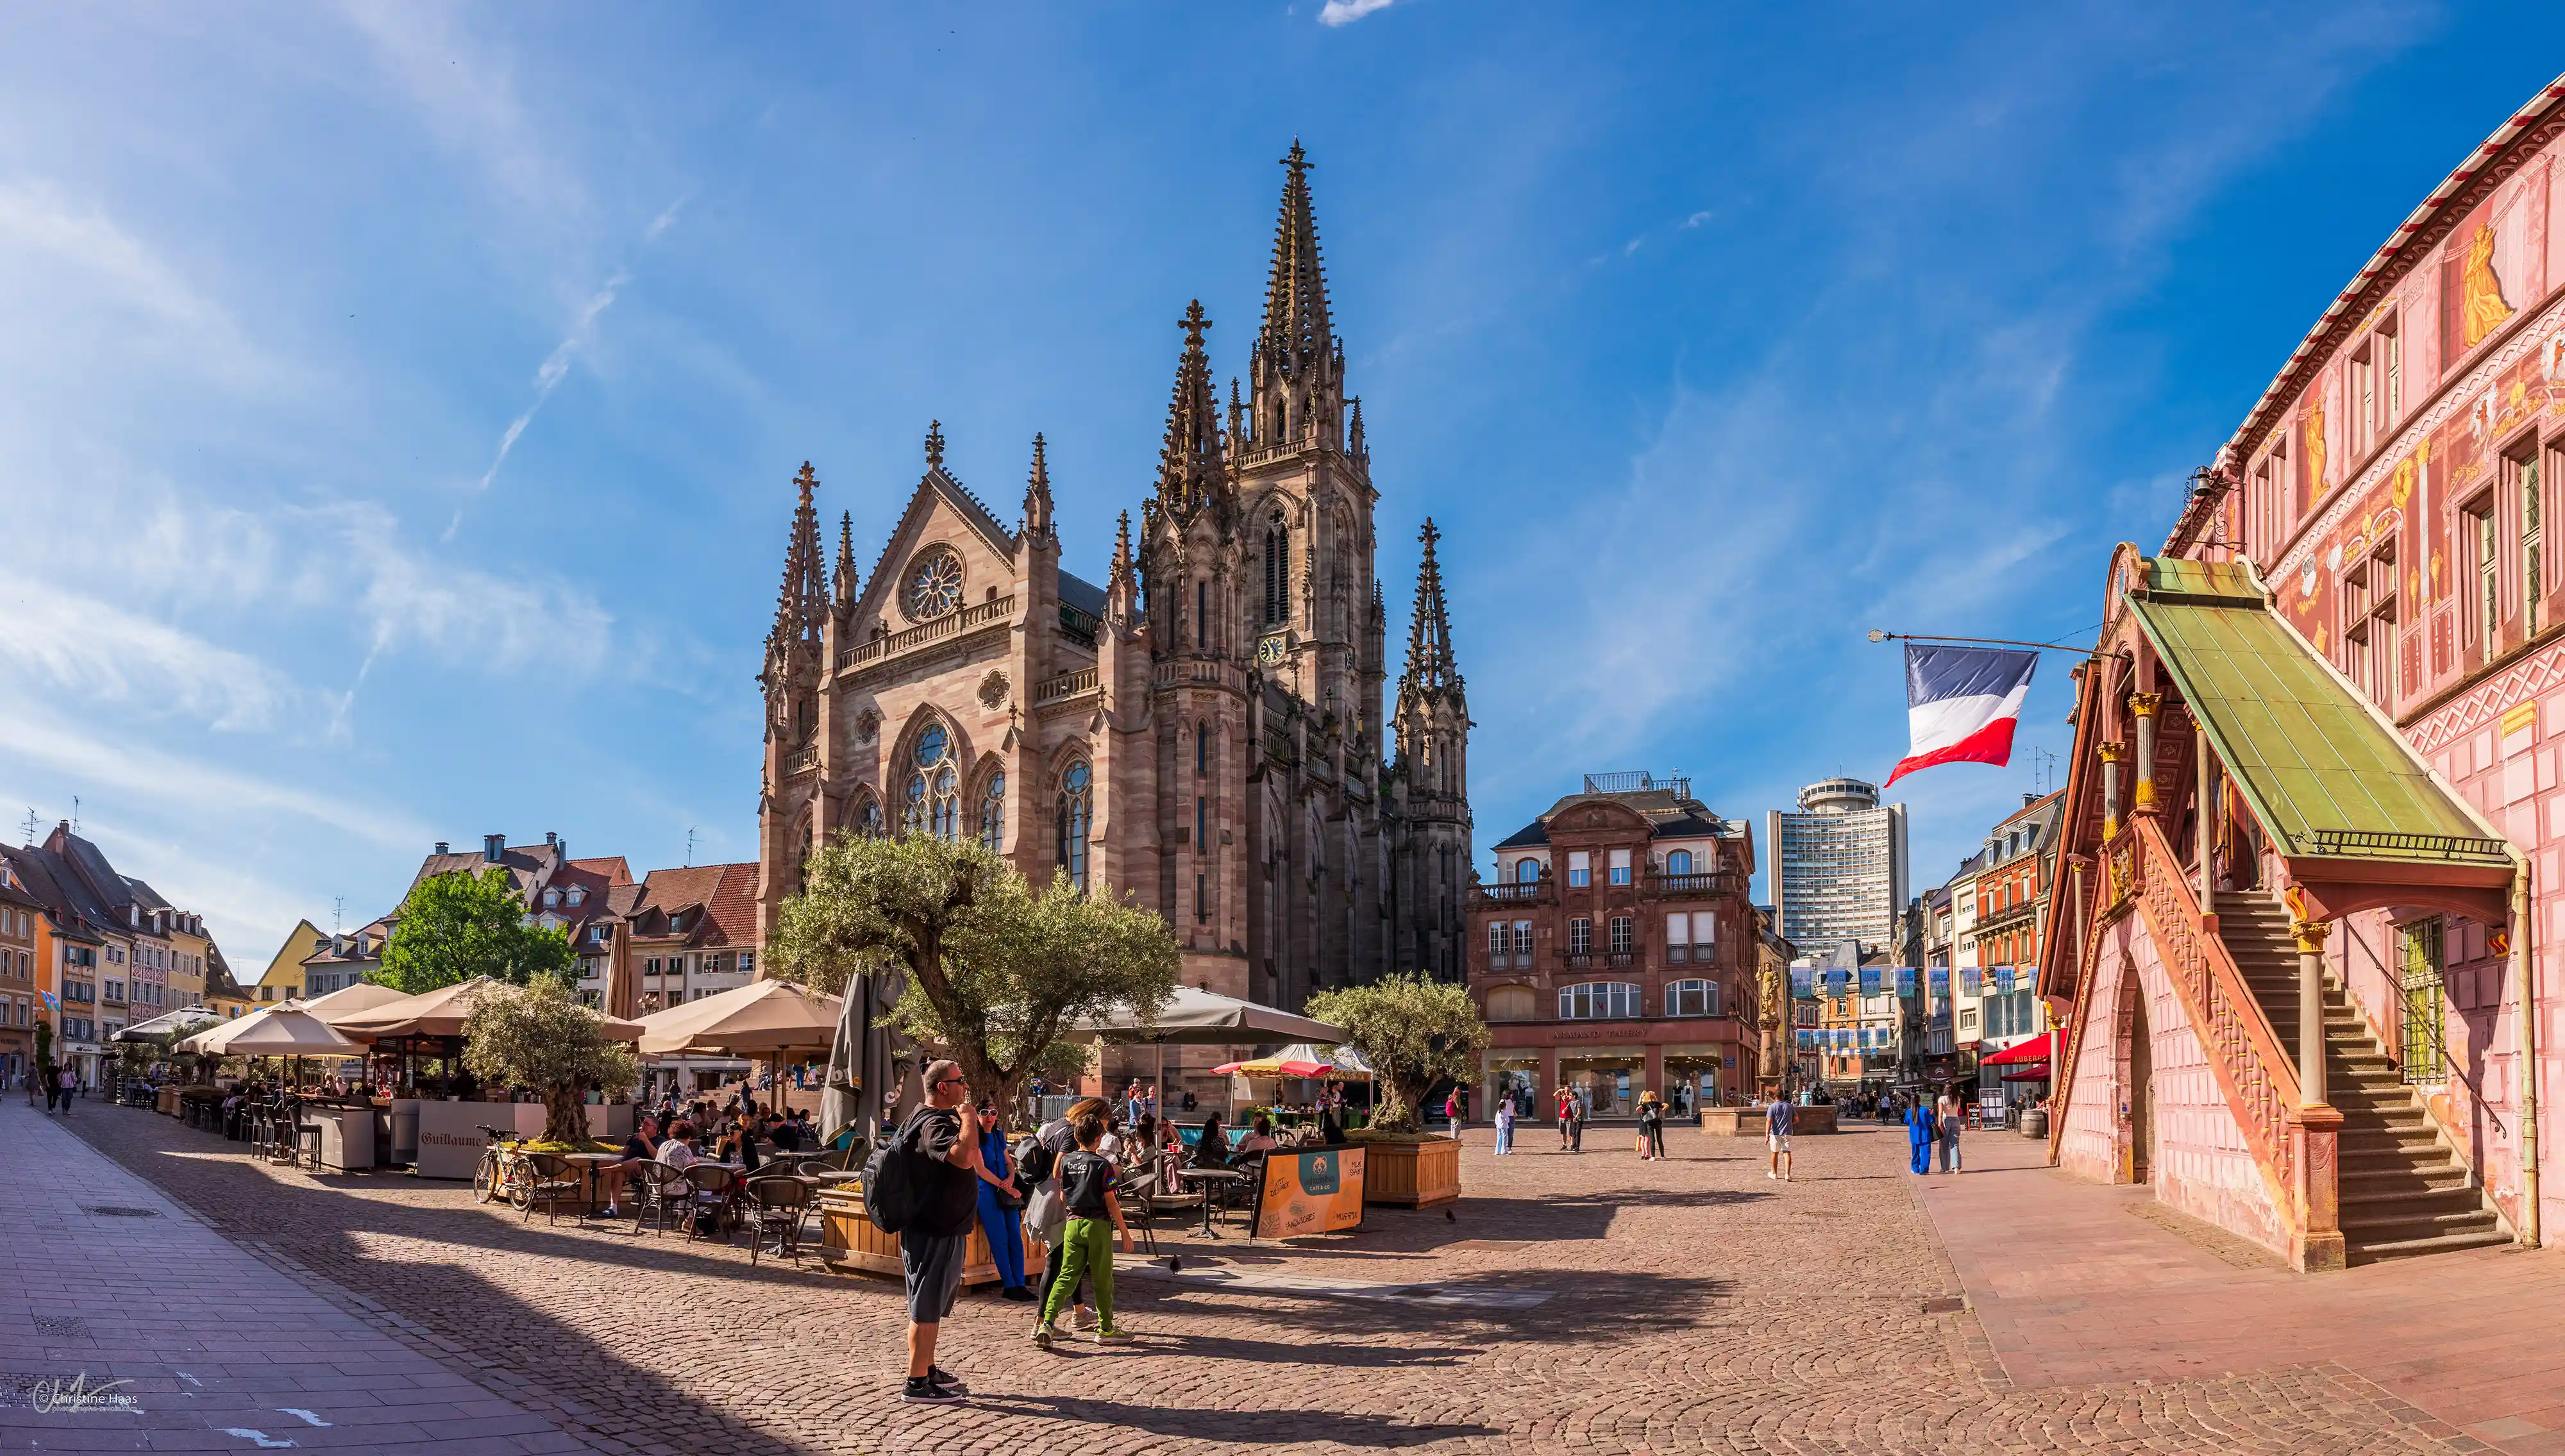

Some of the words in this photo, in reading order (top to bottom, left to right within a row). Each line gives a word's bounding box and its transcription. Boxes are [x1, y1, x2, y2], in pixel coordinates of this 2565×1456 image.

[1553, 1030, 1601, 1039] ARMAND
[421, 1132, 482, 1146] Guillaume
[1067, 1161, 1088, 1171] beko
[1336, 1210, 1358, 1221] MUFFIN
[1285, 1212, 1316, 1231] SANDWICHES
